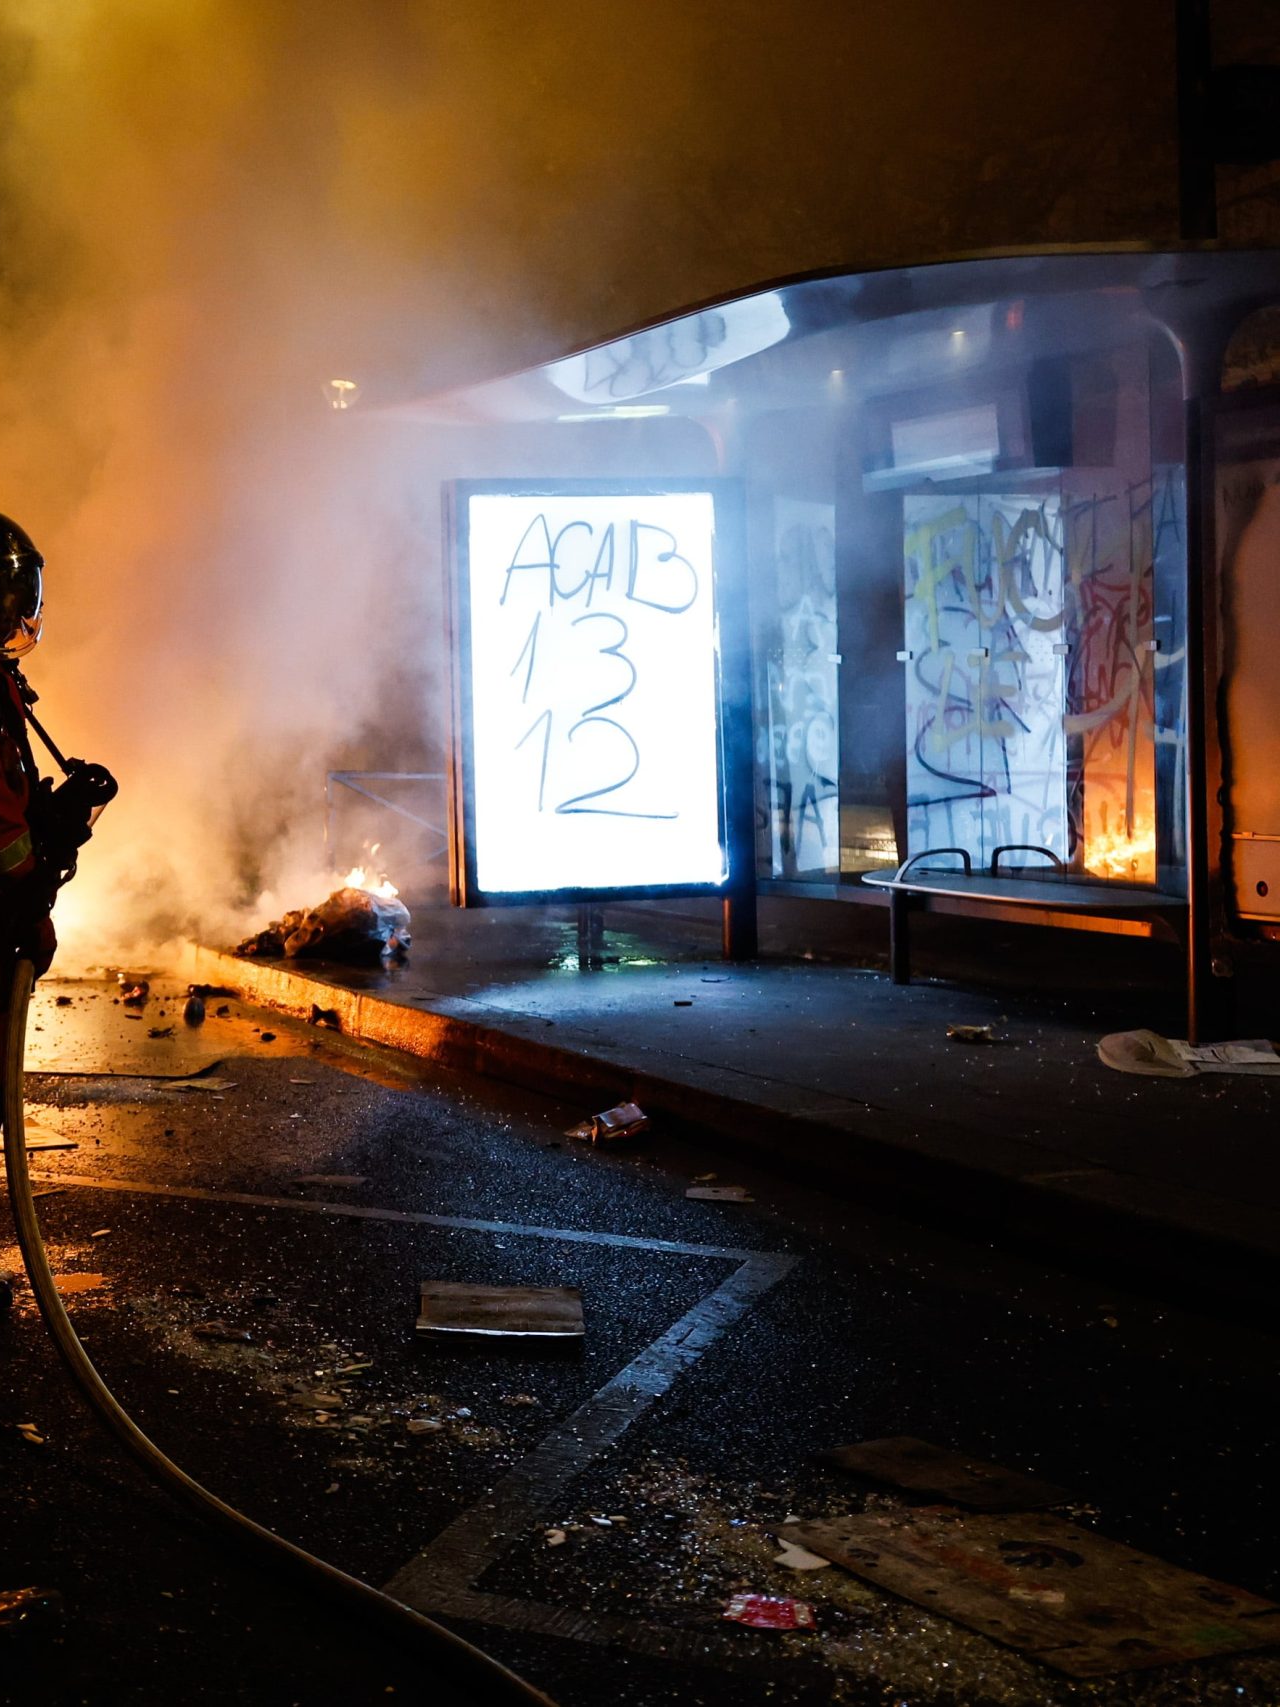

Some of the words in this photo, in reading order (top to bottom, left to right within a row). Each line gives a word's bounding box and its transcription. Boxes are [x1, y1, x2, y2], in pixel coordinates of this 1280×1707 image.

[499, 513, 698, 614] ACAB
[509, 610, 638, 718] 13
[514, 709, 680, 819] 12
